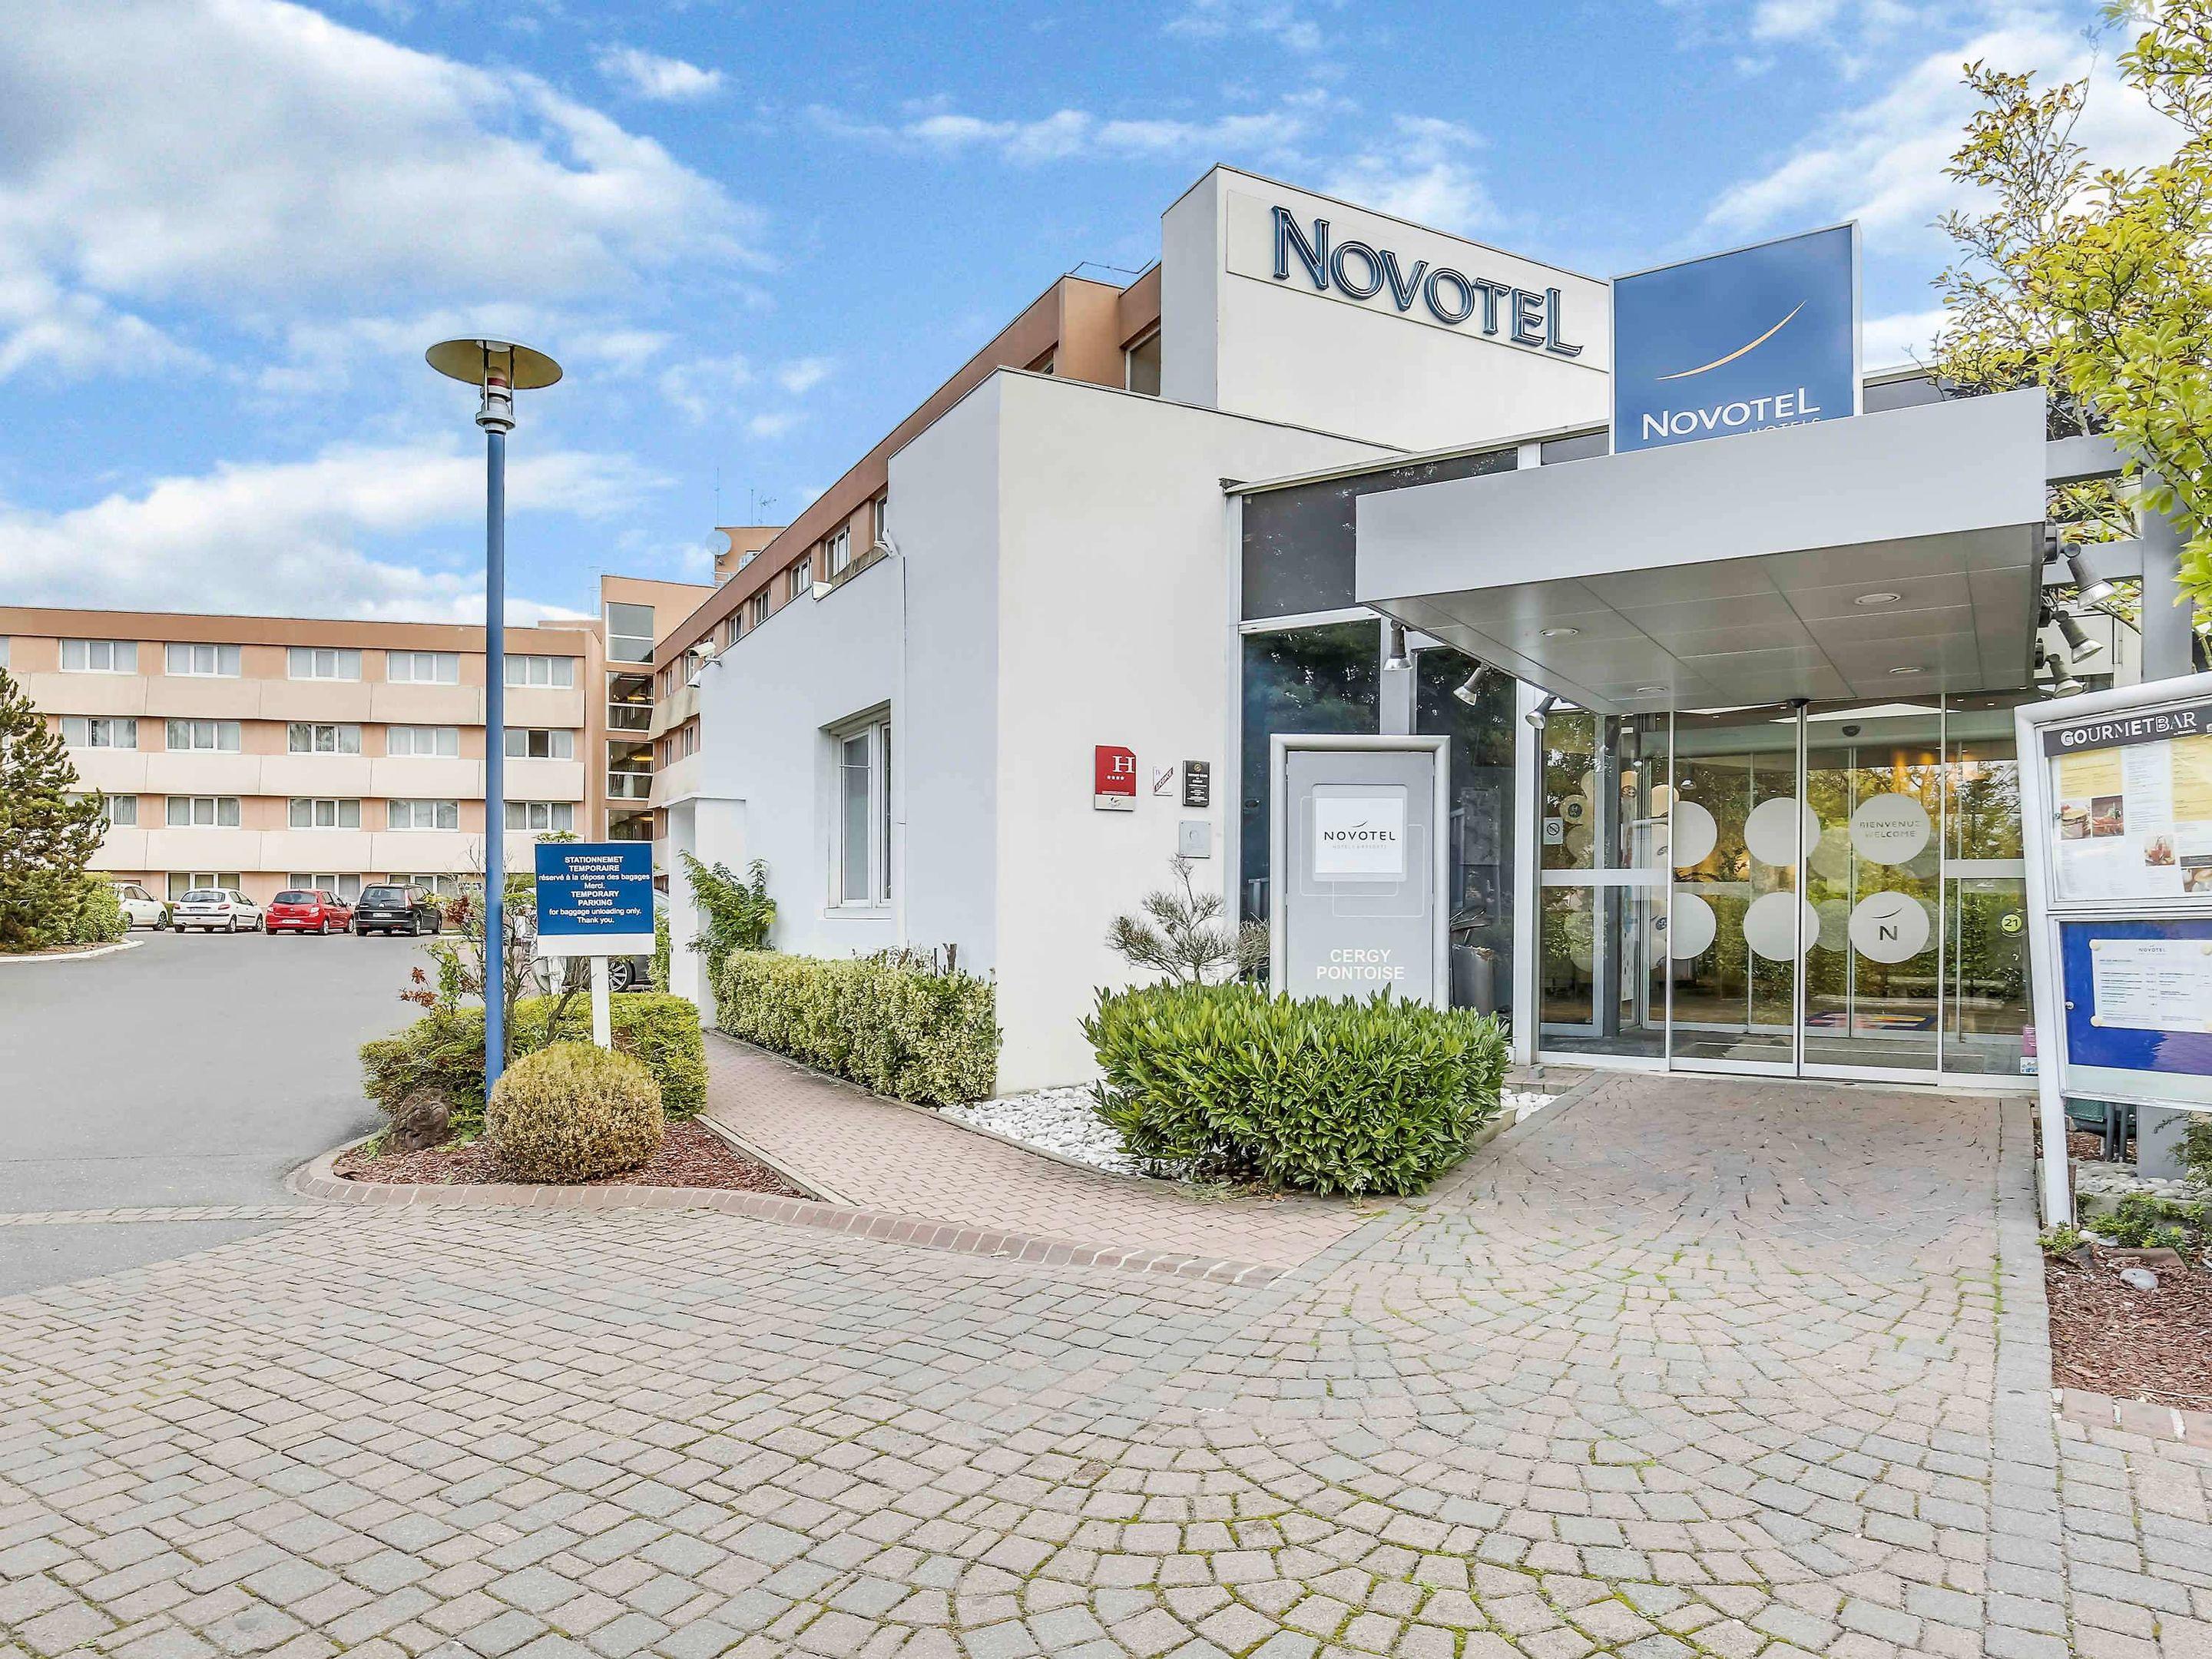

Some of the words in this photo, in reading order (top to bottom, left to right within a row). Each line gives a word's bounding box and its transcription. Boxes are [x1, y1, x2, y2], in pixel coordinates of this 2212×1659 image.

[1271, 204, 1584, 357] NOVOTEL
[1642, 386, 1821, 441] NOVOTEL
[1112, 755, 1135, 773] H
[1324, 831, 1396, 841] NOVOTEL
[580, 873, 605, 882] dépose
[621, 873, 651, 882] bagages
[560, 908, 591, 916] baggage
[2005, 919, 2018, 927] 21
[1879, 926, 1897, 941] N
[1330, 949, 1392, 963] CERGY
[1316, 965, 1405, 980] PONTOISE
